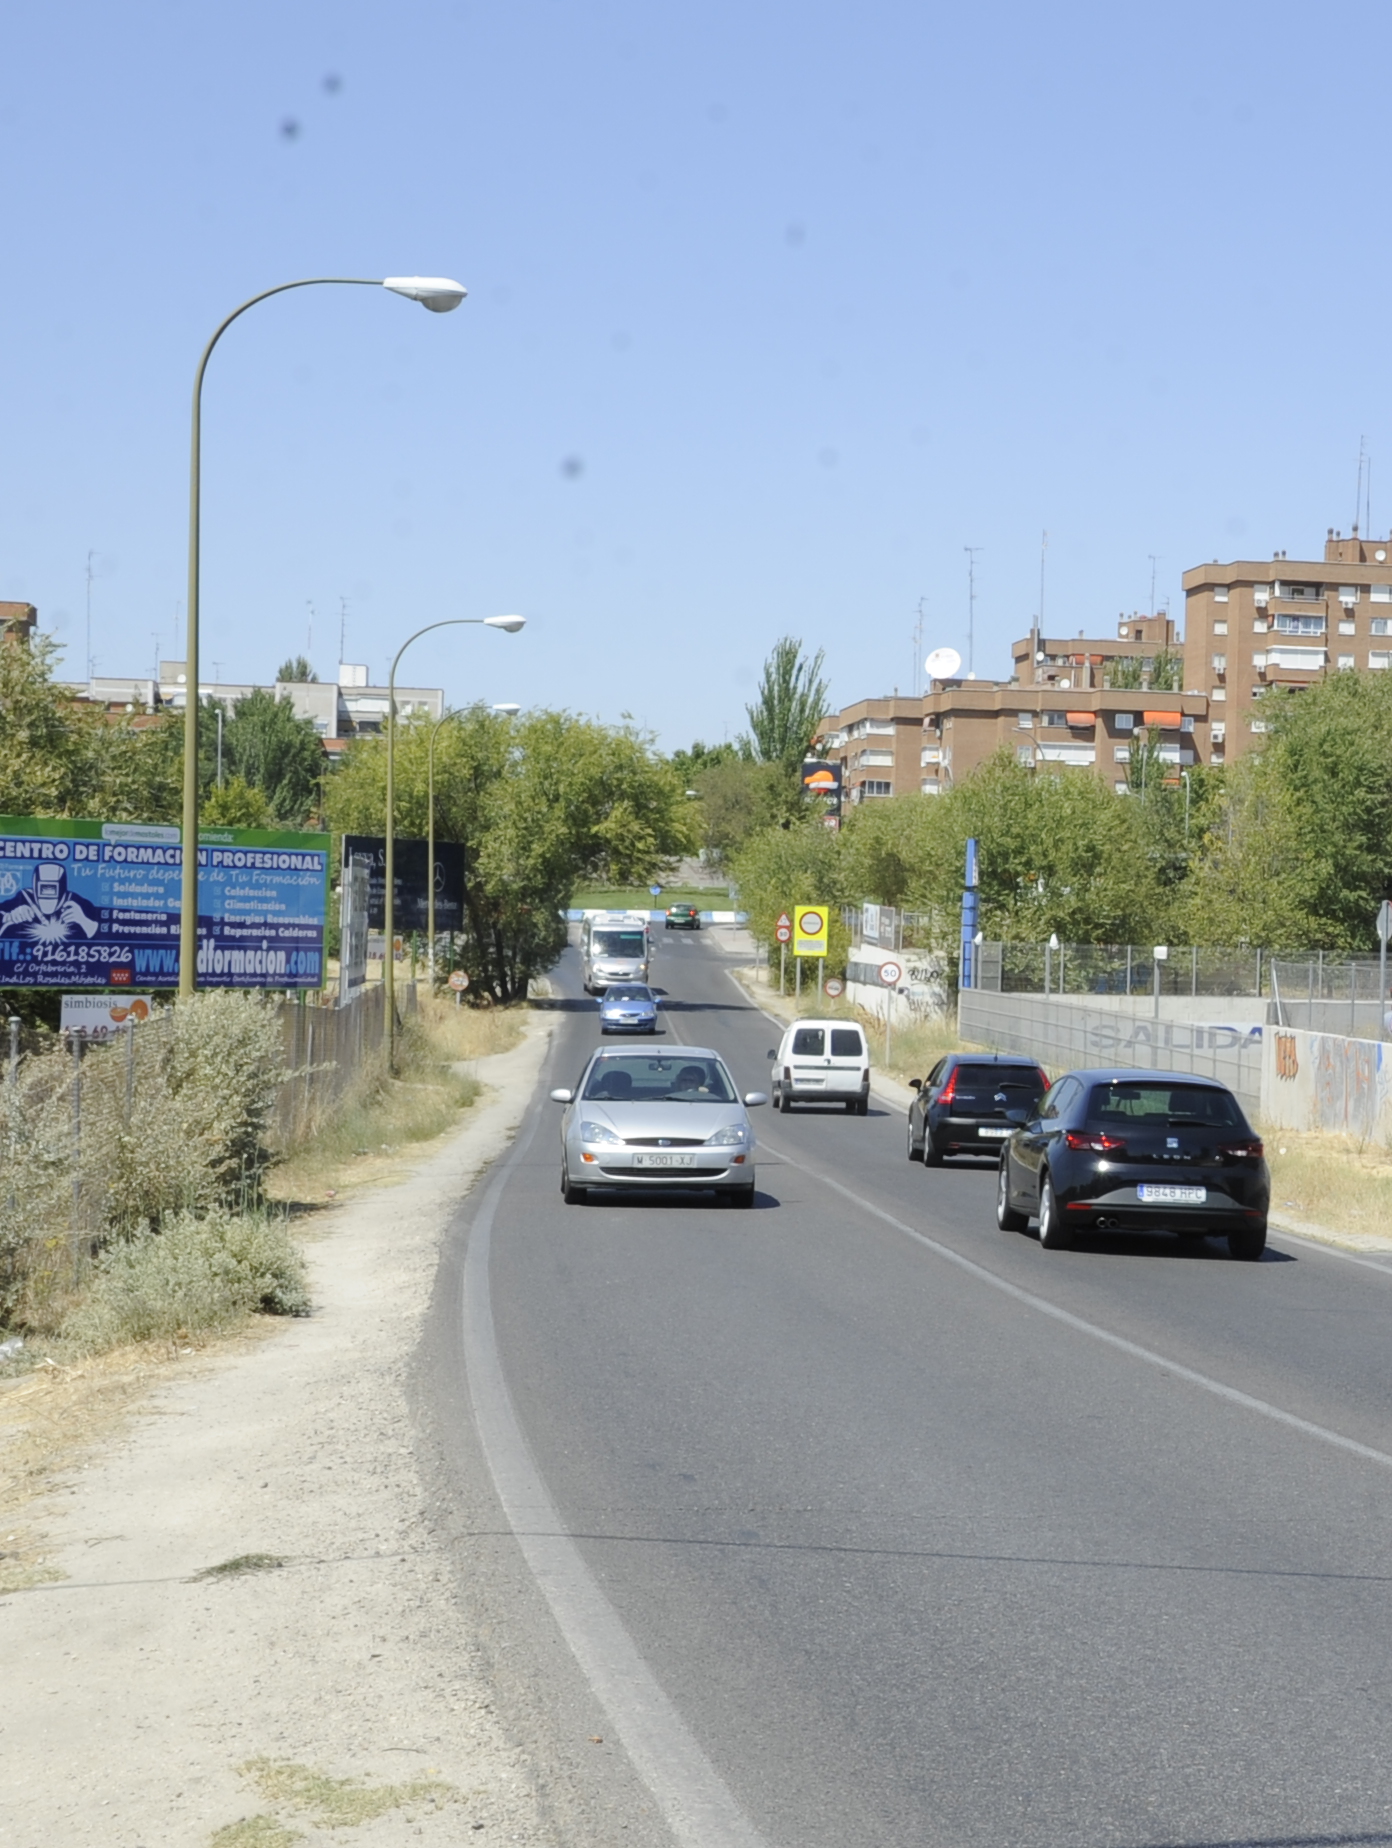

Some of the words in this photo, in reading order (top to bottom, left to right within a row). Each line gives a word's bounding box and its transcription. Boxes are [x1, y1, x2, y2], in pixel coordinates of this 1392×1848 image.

[74, 844, 98, 861] DE
[104, 845, 207, 866] FORMACIN
[212, 850, 322, 870] PROFESIONAL
[71, 863, 94, 877] Tu
[97, 865, 146, 879] Futuro
[149, 866, 207, 884] depee
[209, 869, 227, 882] de
[230, 870, 250, 883] Tu
[252, 870, 320, 886] Formación
[113, 882, 165, 894] Soldadura
[224, 886, 277, 898] Calefacción
[113, 896, 165, 908] Instalador
[224, 900, 287, 911] Climatización
[112, 909, 168, 921] Fontanería
[267, 914, 318, 925] Renovables
[112, 923, 168, 935] Prevención
[224, 927, 275, 938] Reparación
[278, 928, 318, 938] Calderas
[33, 945, 132, 963] 916185826
[134, 938, 320, 974] www.dformacion.com
[81, 964, 87, 972] 2
[883, 967, 898, 979] 50
[63, 997, 118, 1009] simbiosis
[1089, 1024, 1262, 1050] SALIDA
[1146, 1185, 1176, 1198] 9848
[1179, 1187, 1203, 1200] HPC
